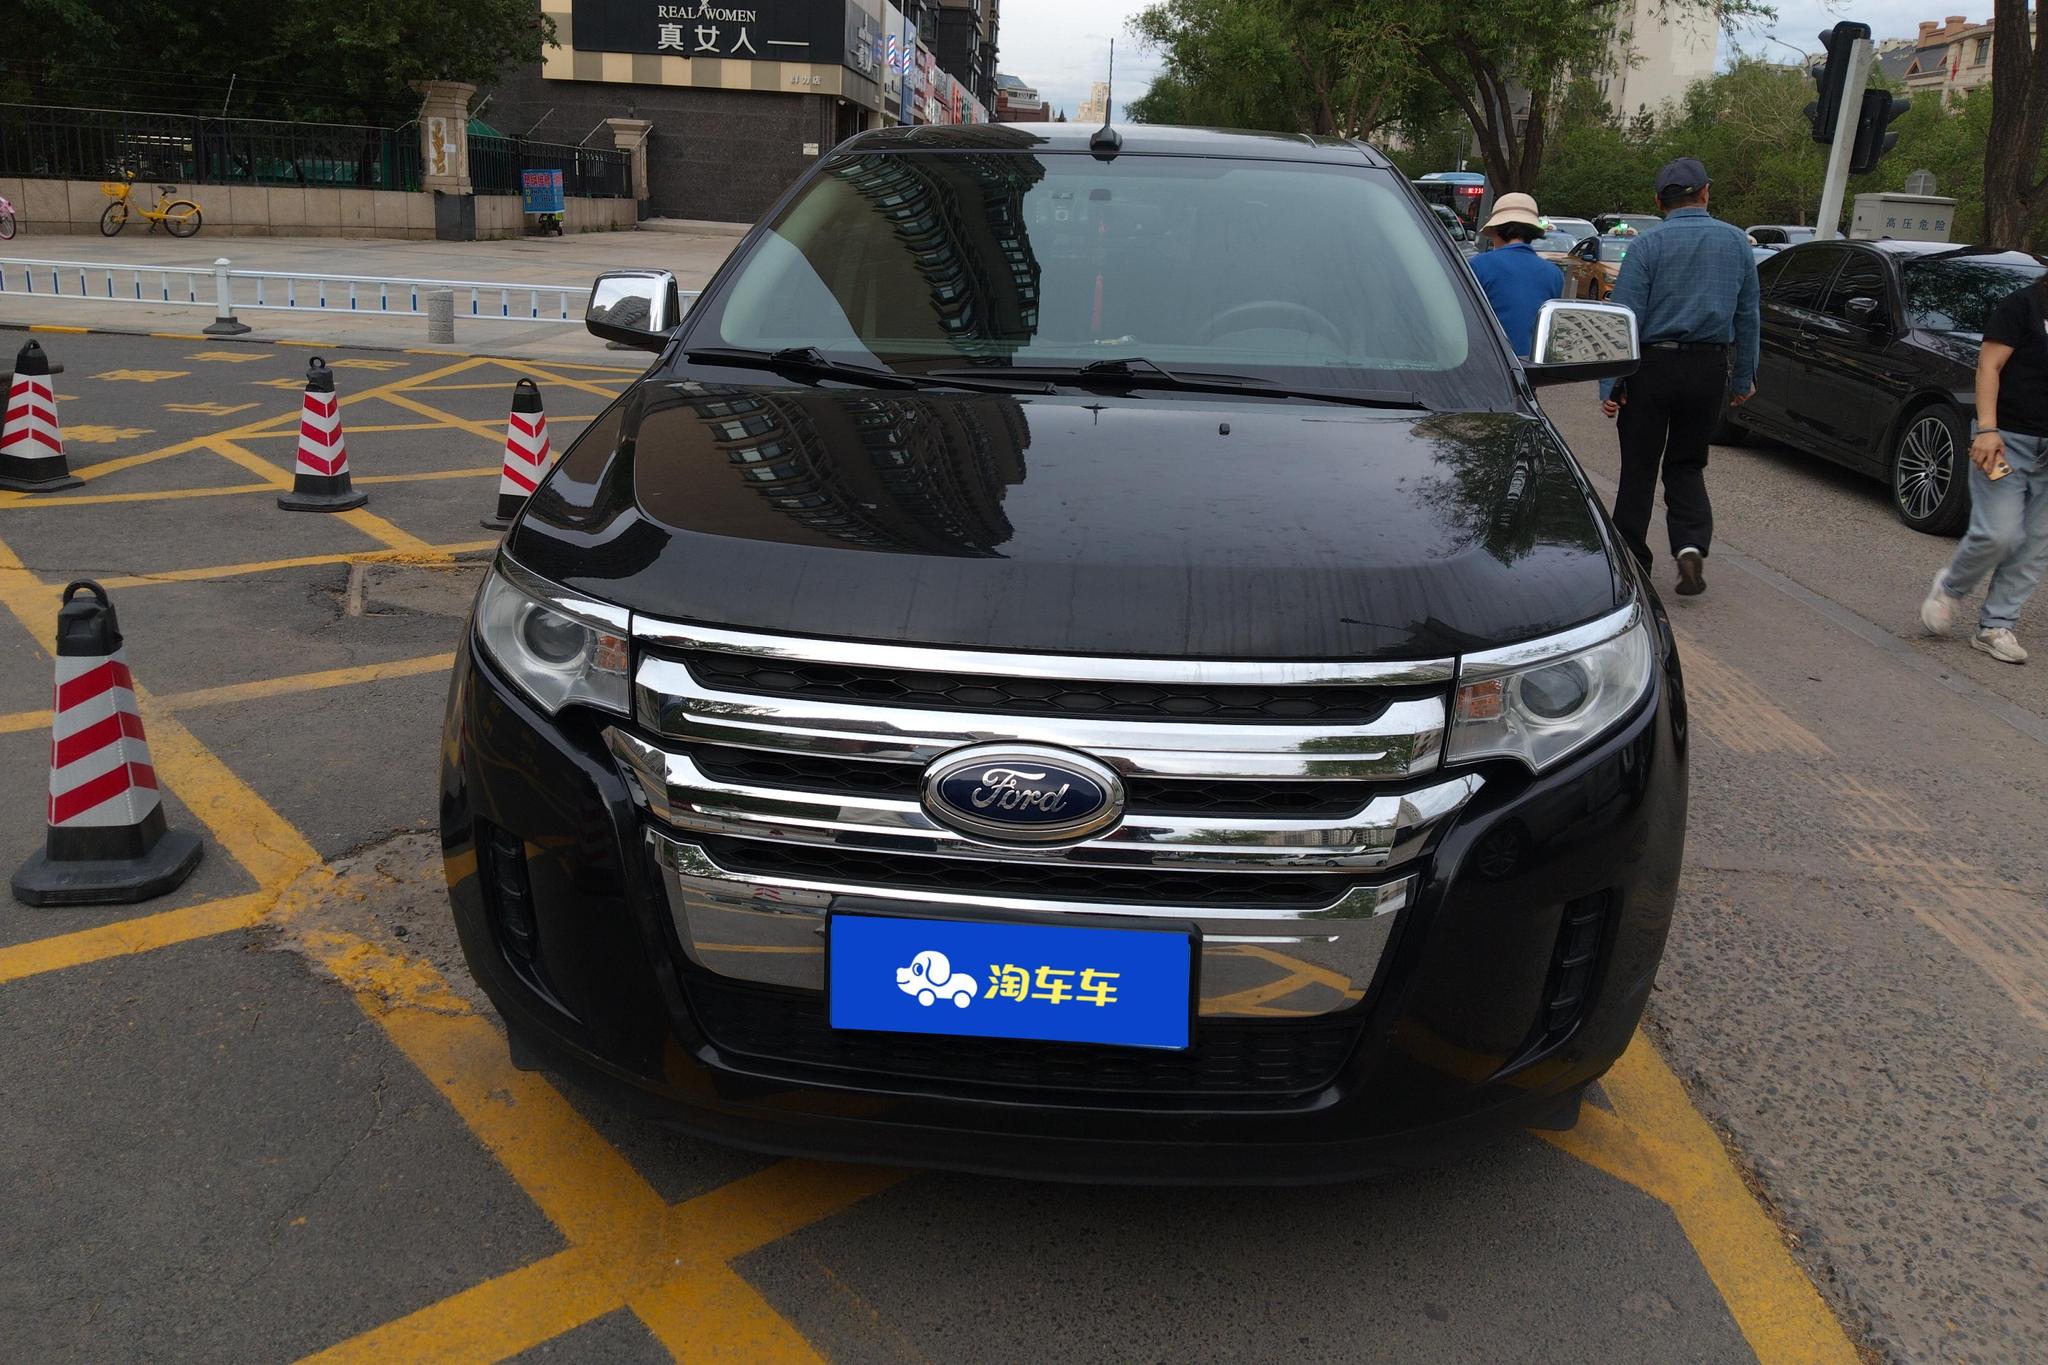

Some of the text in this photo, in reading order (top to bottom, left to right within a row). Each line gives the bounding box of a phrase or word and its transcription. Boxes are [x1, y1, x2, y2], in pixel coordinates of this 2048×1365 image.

[657, 5, 757, 22] REAL WOMEN
[1886, 216, 1946, 232] 高压危险
[970, 768, 1072, 812] Ford
